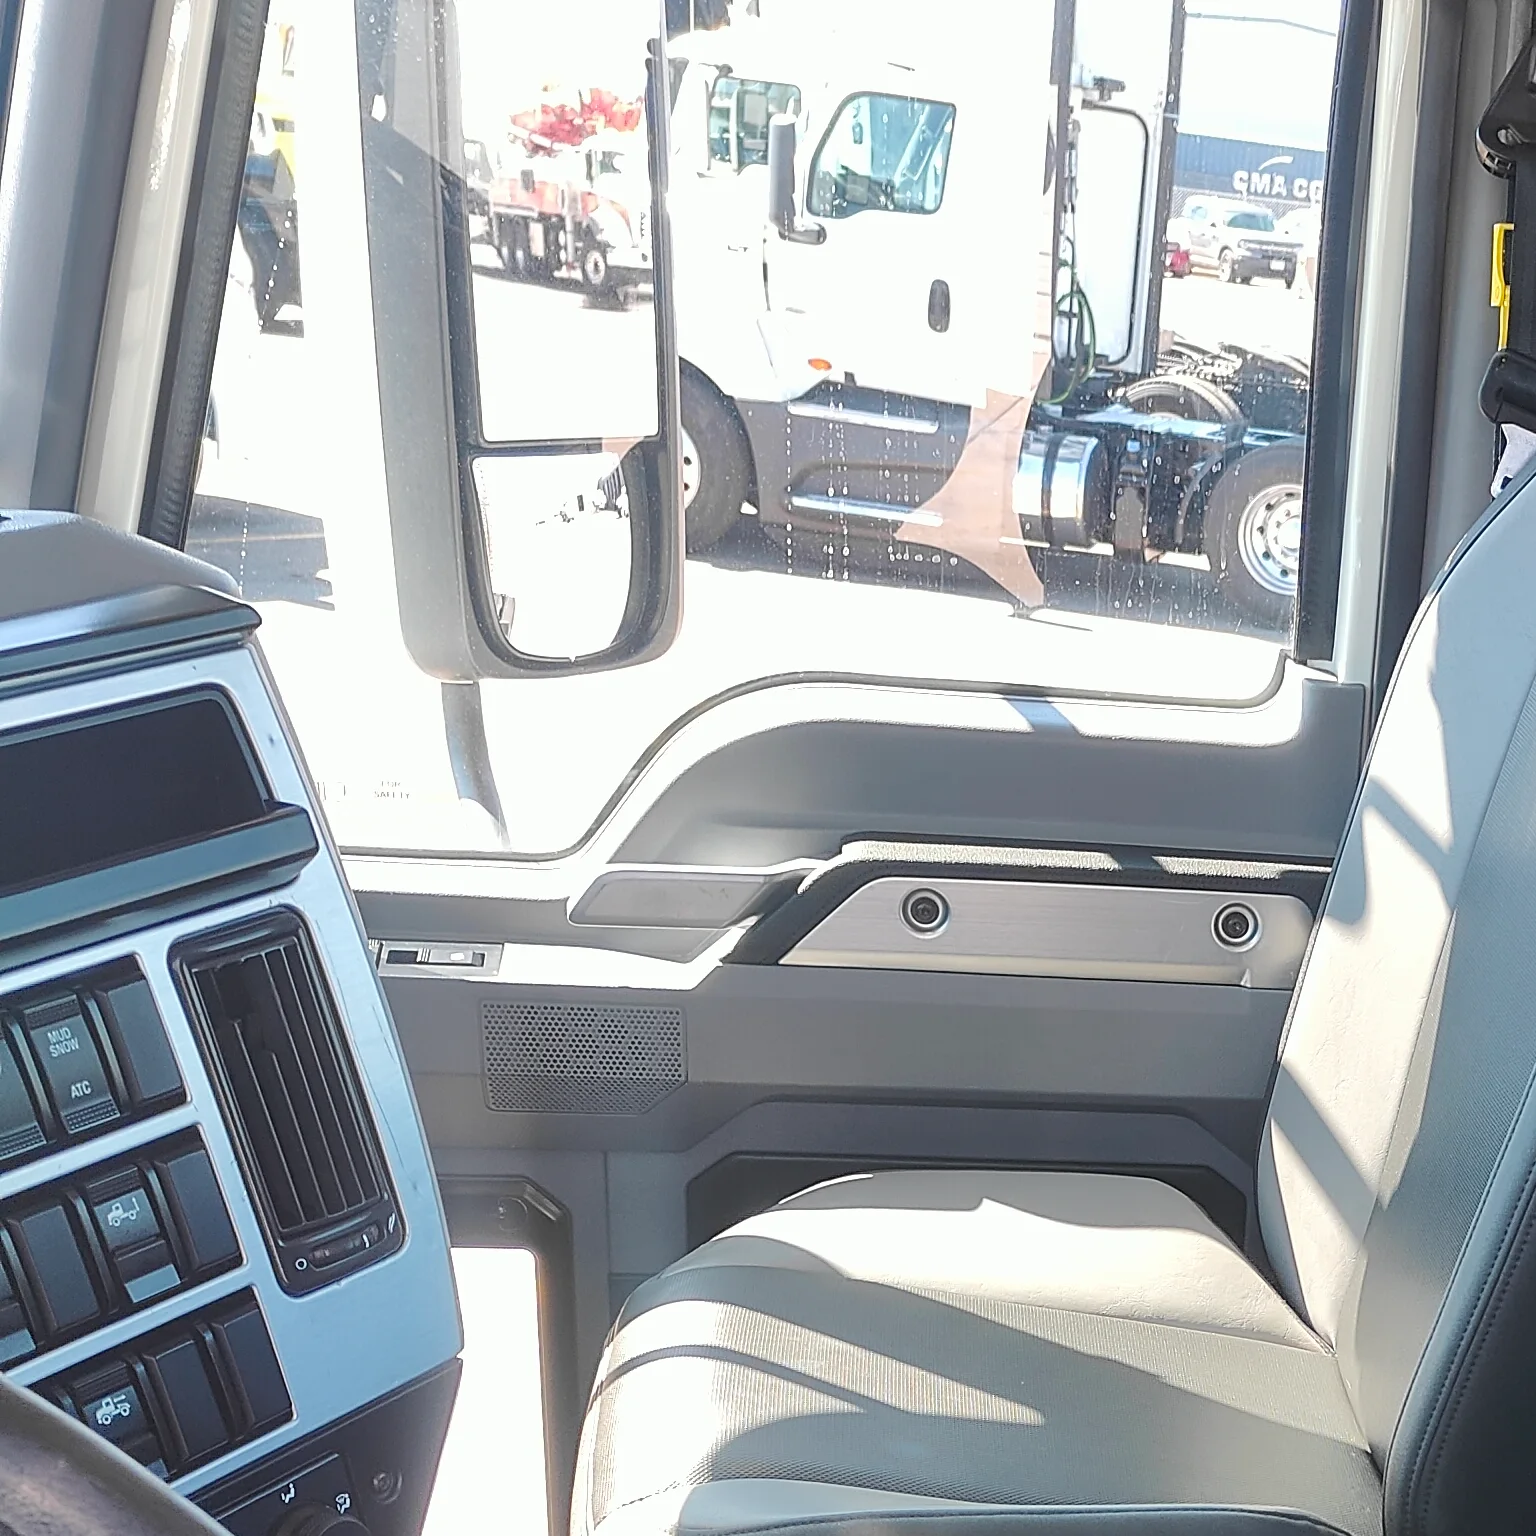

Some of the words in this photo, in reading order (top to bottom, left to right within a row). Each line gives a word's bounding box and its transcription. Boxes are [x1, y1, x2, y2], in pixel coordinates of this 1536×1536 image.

[1232, 170, 1287, 197] CMA
[47, 1026, 72, 1044] MUD
[49, 1037, 80, 1057] SNOW
[70, 1080, 92, 1099] ATC
